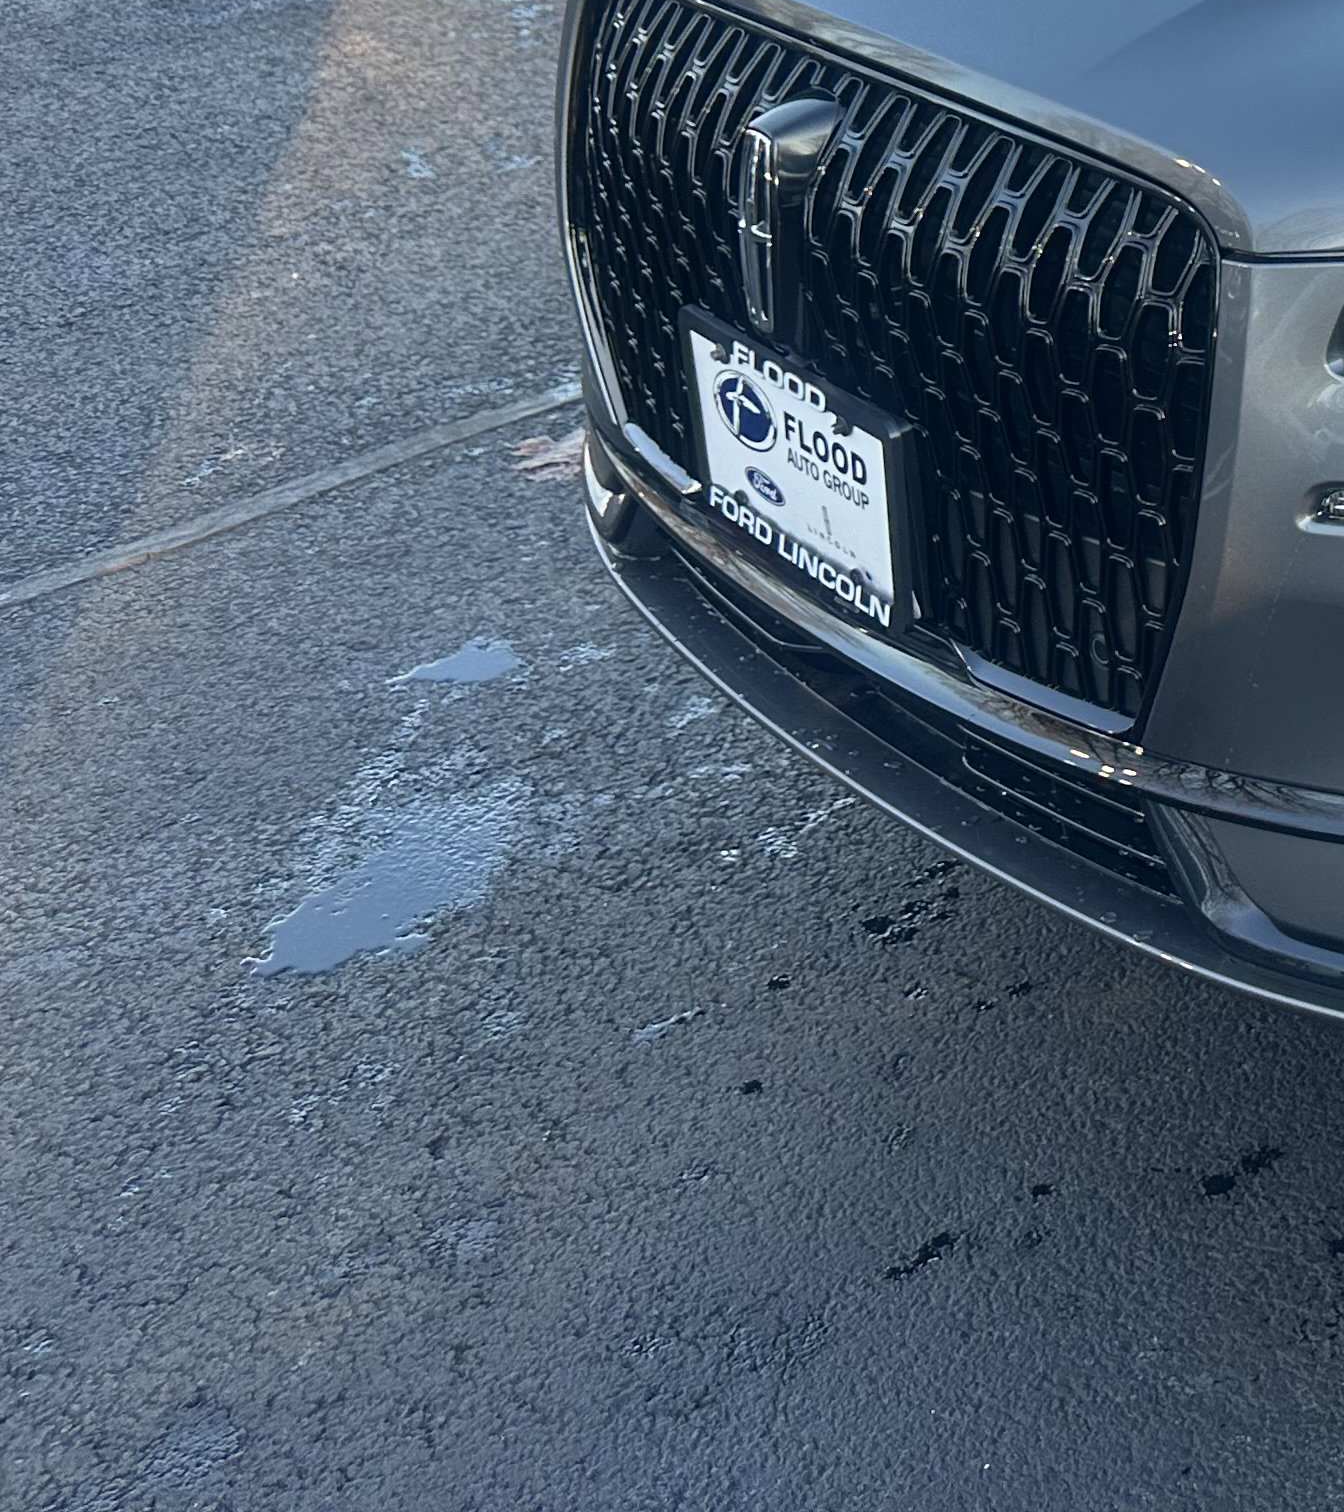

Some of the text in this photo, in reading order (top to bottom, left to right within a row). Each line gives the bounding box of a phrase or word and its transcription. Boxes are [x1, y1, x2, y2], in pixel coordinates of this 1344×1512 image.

[731, 340, 827, 413] FLOOD
[783, 411, 868, 486] FLOOD
[787, 447, 870, 510] AUTO GROUP
[709, 485, 891, 628] FORD LINCOLN
